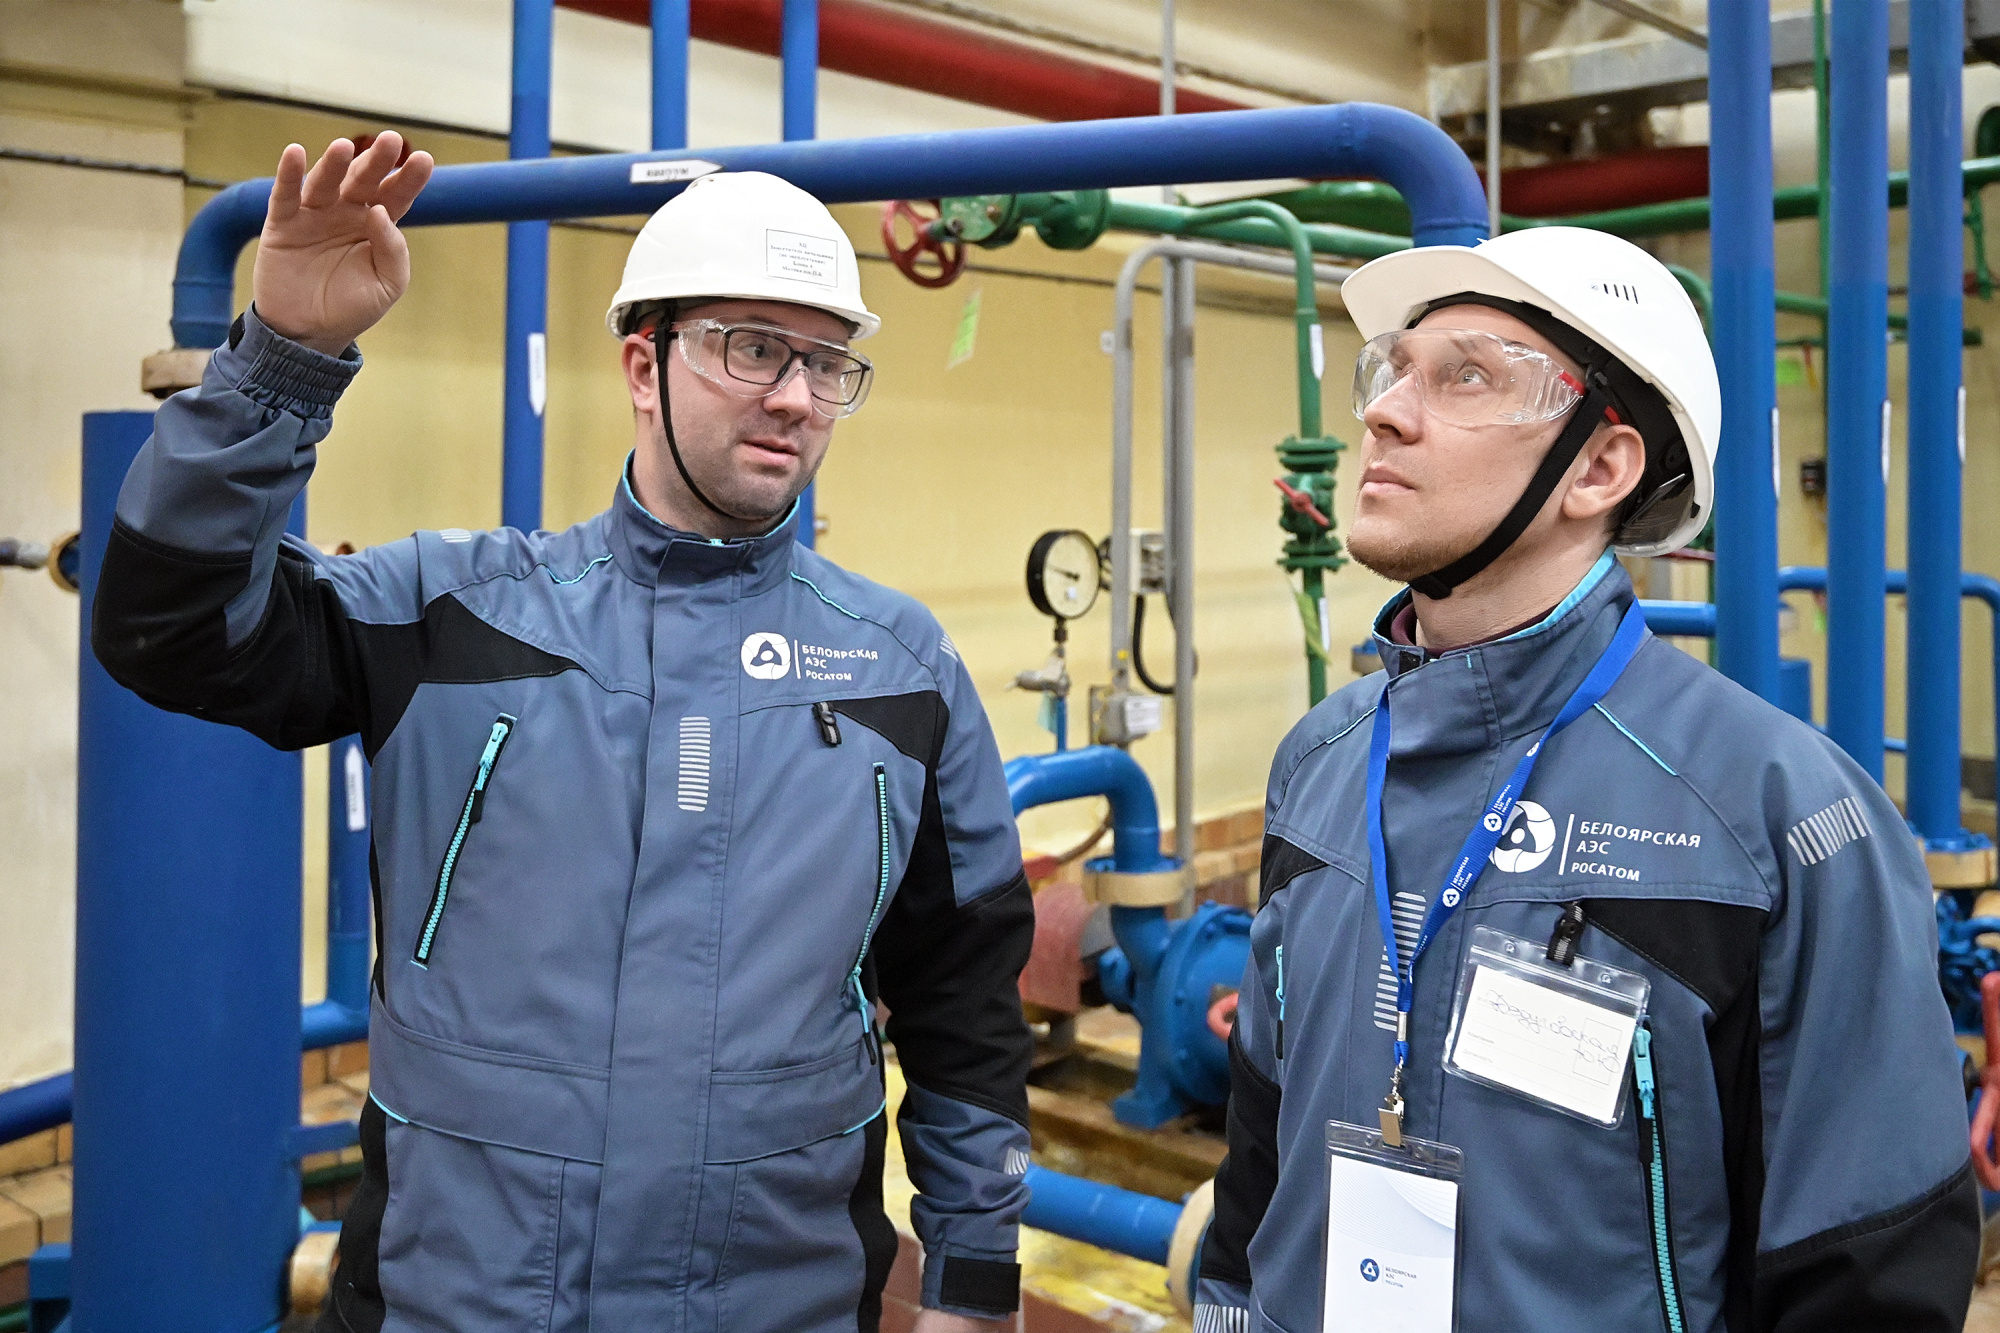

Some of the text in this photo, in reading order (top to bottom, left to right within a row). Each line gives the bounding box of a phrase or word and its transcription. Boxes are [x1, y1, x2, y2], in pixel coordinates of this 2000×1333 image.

[801, 644, 879, 660] БЕЛОЯРСКАЯ
[804, 656, 828, 669] АЭС
[805, 669, 853, 681] РОСАТОМ
[1579, 821, 1701, 848] БЕЛОЯРСКАЯ
[1575, 840, 1611, 855] АЭС
[1571, 862, 1640, 882] РОСАТОМ
